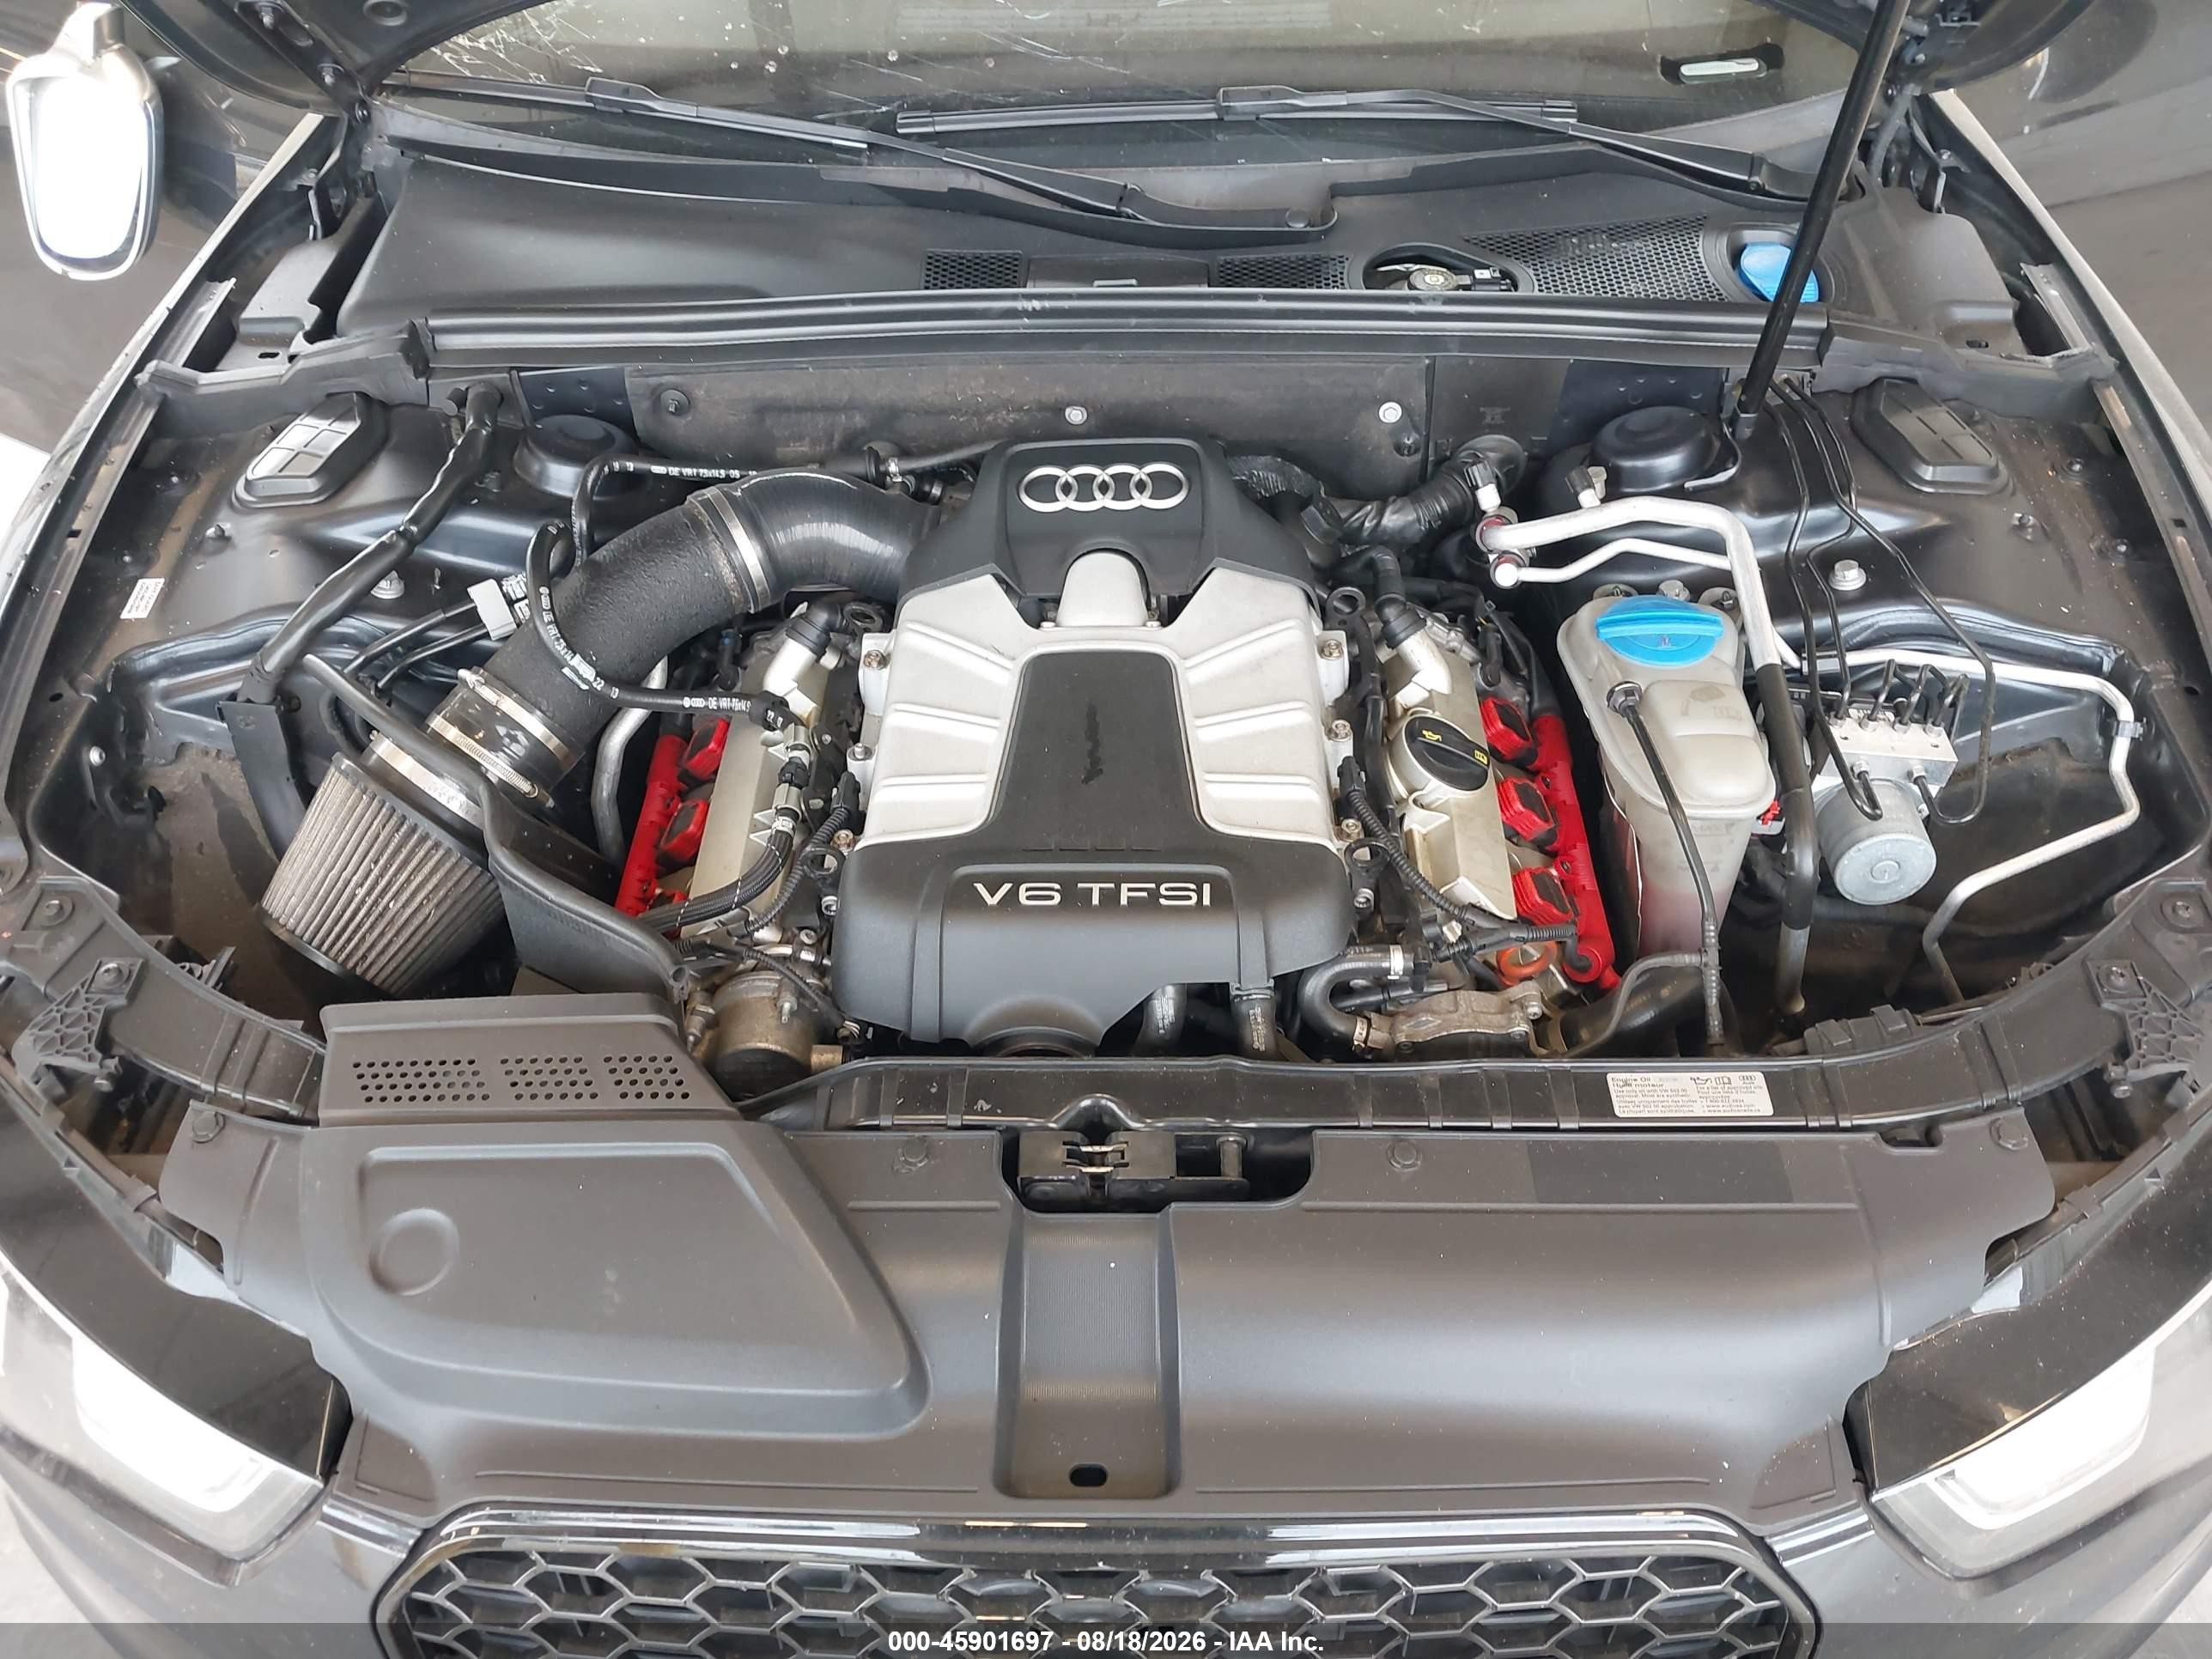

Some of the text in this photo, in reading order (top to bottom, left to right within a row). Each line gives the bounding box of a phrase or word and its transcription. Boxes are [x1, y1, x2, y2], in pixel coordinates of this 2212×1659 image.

[668, 466, 680, 477] DE
[708, 696, 718, 709] DE
[973, 882, 1212, 907] V6 TFSI
